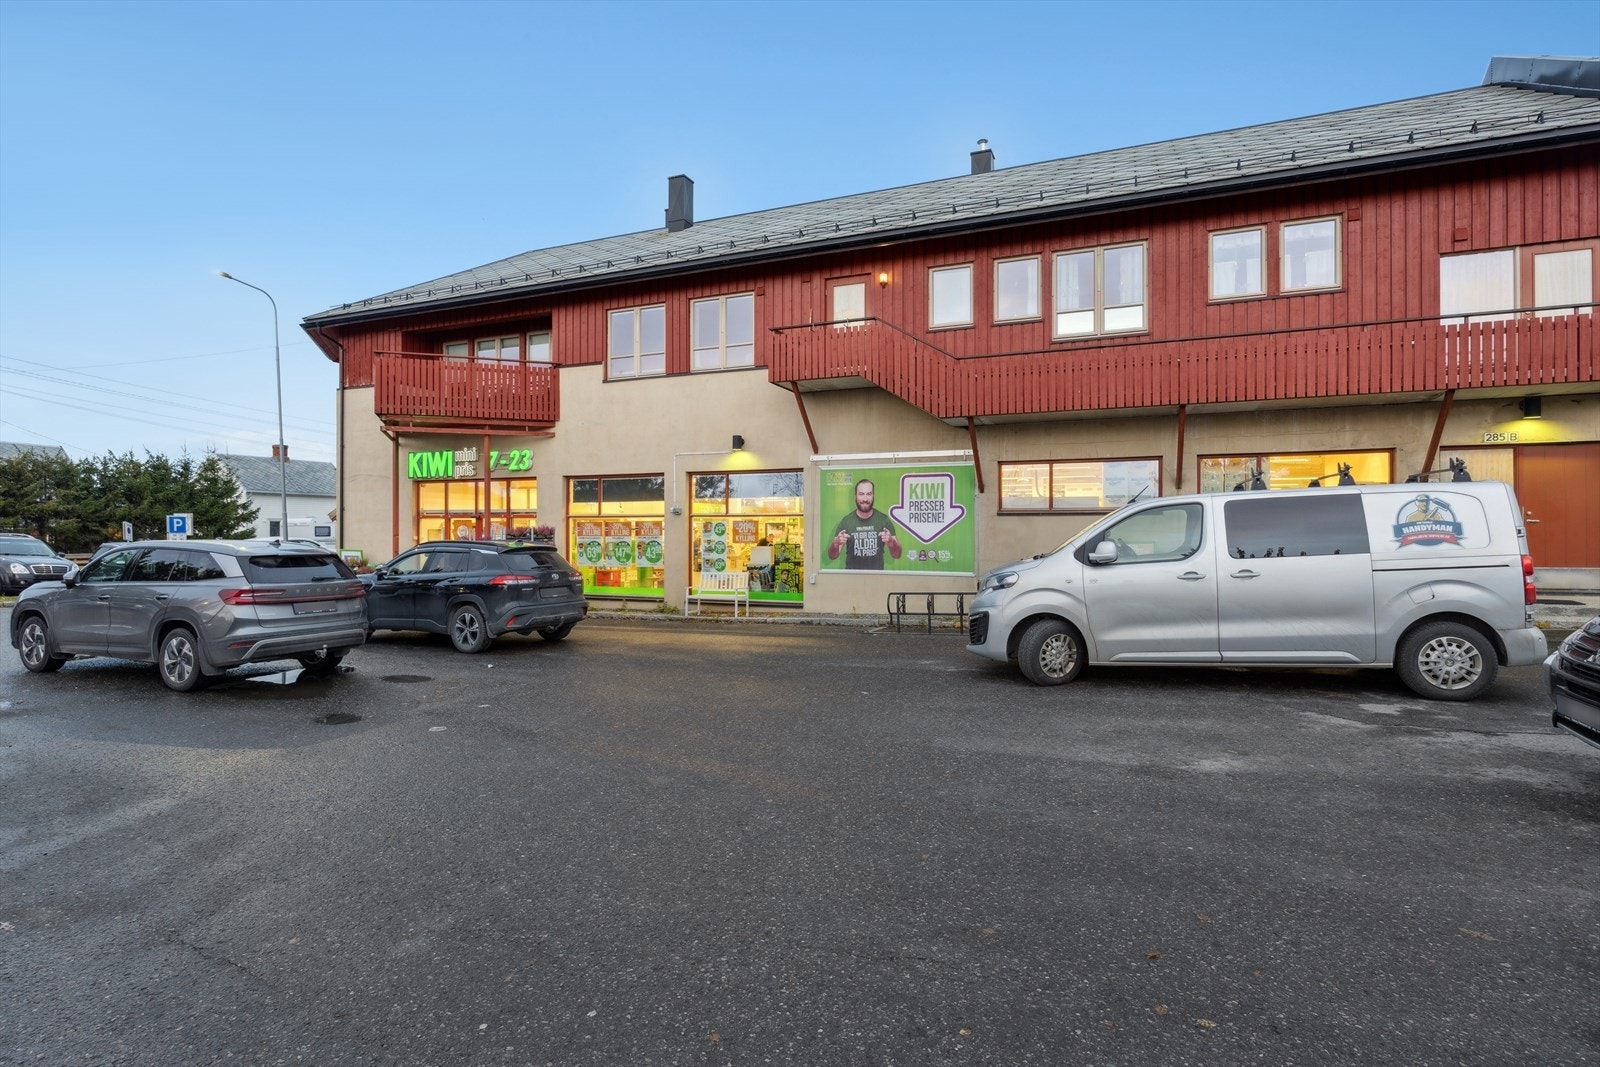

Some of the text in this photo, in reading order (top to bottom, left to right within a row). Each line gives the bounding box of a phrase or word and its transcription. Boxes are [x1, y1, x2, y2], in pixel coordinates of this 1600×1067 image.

[1486, 433, 1517, 441] 285 B
[455, 447, 477, 461] mini
[408, 450, 453, 479] KIWI
[455, 462, 476, 478] pris
[909, 483, 945, 499] KIWI
[909, 501, 945, 511] PRESSER
[909, 512, 945, 523] PRISENE!
[174, 519, 183, 531] P
[736, 522, 756, 533] -20%
[1402, 524, 1453, 533] HANDYMAN
[868, 531, 877, 539] OSS
[854, 539, 878, 549] ALDRI
